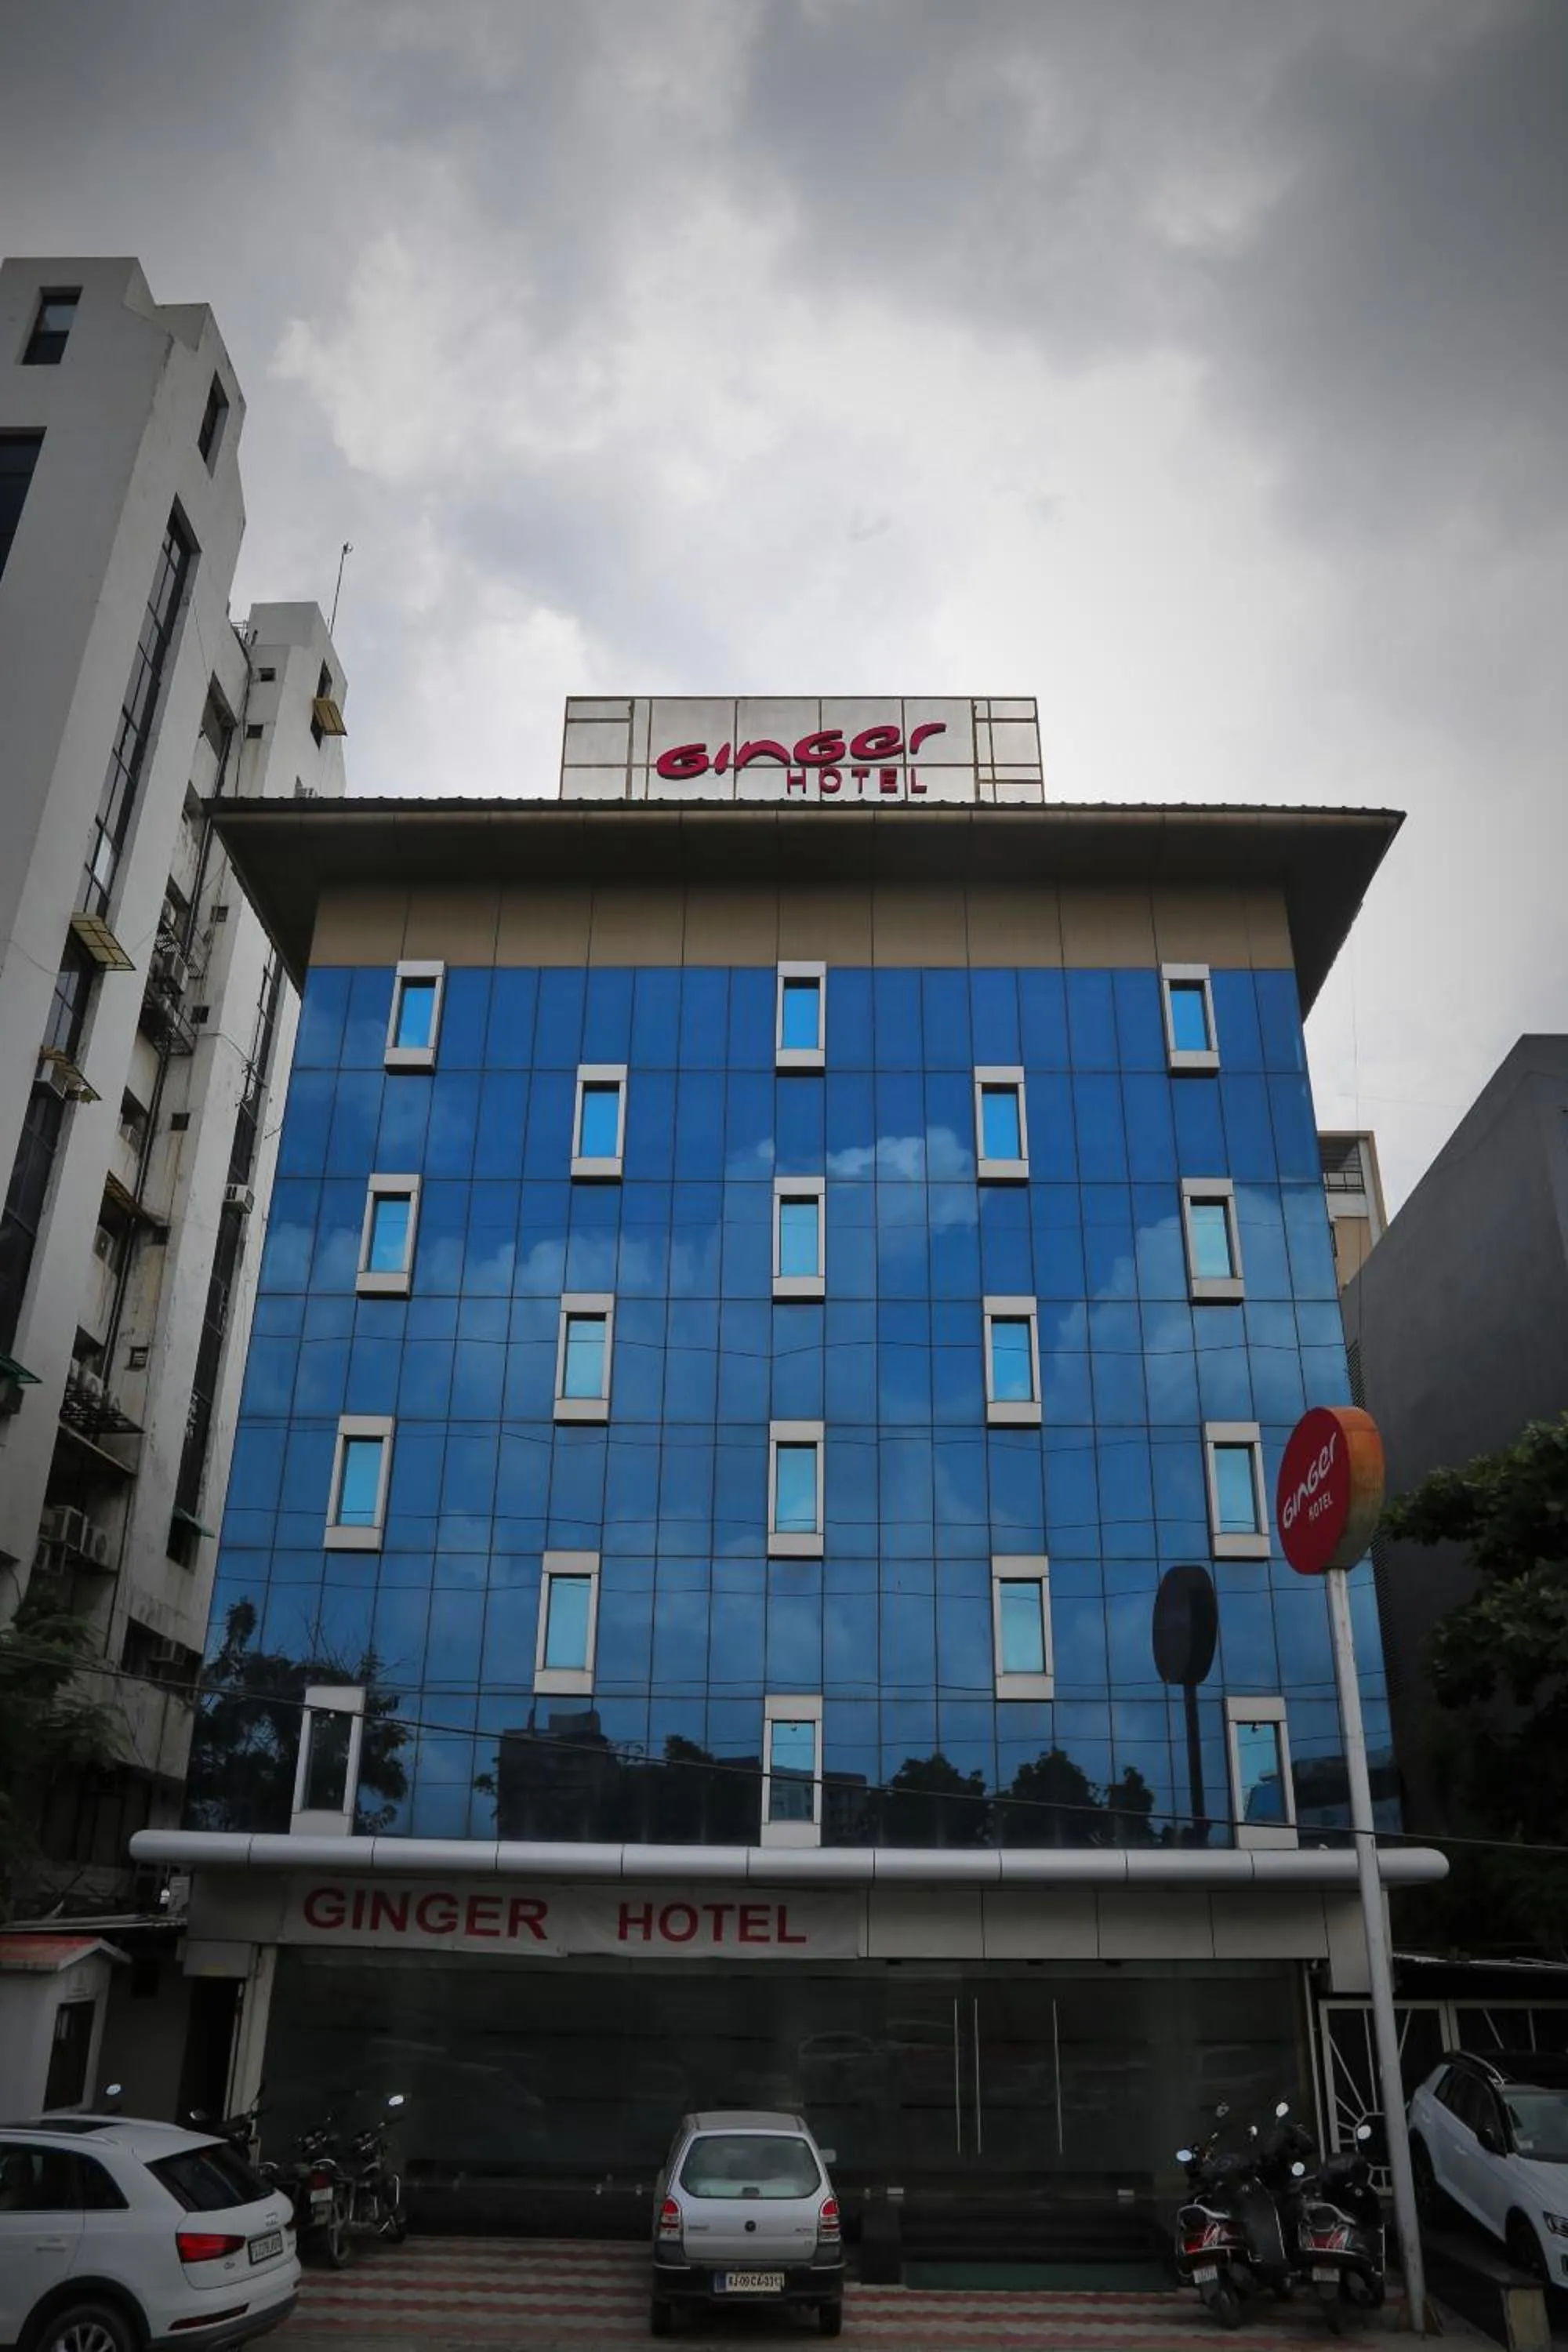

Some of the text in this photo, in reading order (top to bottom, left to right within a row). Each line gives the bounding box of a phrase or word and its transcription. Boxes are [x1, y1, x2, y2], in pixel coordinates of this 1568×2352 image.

[786, 766, 928, 795] HOTEL
[1308, 1492, 1334, 1521] HOTEL
[303, 1887, 808, 1945] GINGER HOTEL
